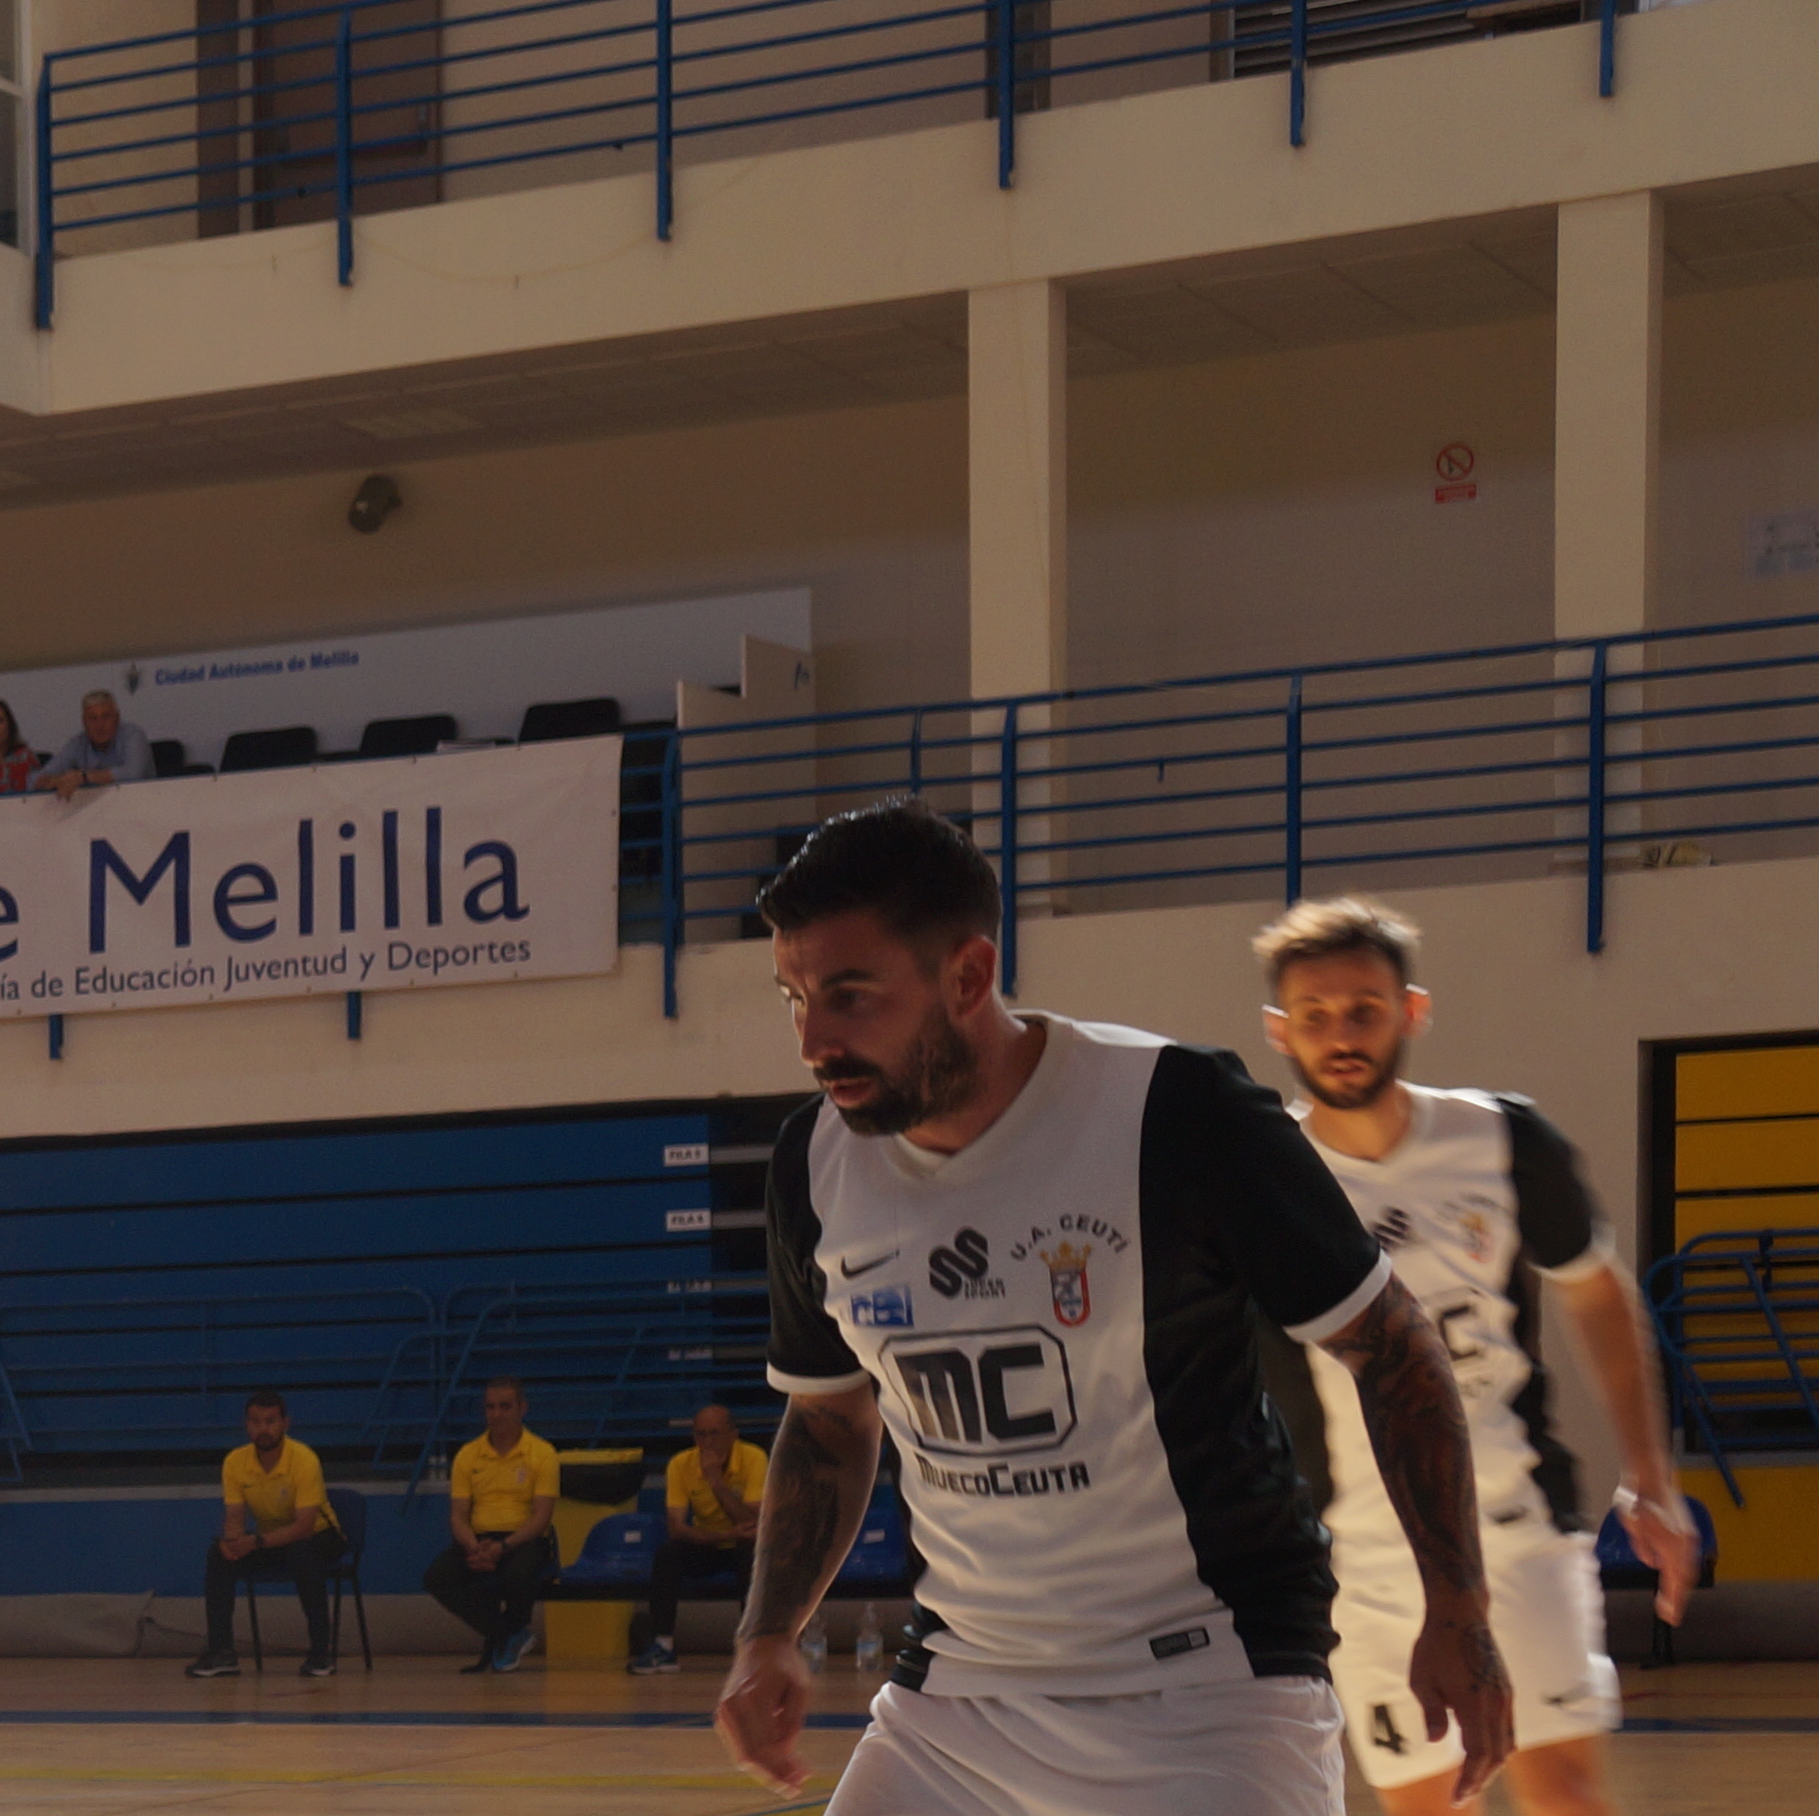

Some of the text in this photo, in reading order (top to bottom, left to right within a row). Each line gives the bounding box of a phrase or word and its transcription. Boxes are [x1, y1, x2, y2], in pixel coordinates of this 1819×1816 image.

[288, 655, 306, 672] de
[87, 808, 531, 950] Melilla
[32, 970, 64, 999] de
[75, 958, 215, 996] Educación
[225, 946, 348, 992] Juventud
[358, 951, 377, 981] y
[389, 939, 532, 977] Deportes
[894, 1341, 1057, 1443] MC
[1372, 1704, 1404, 1753] 4
